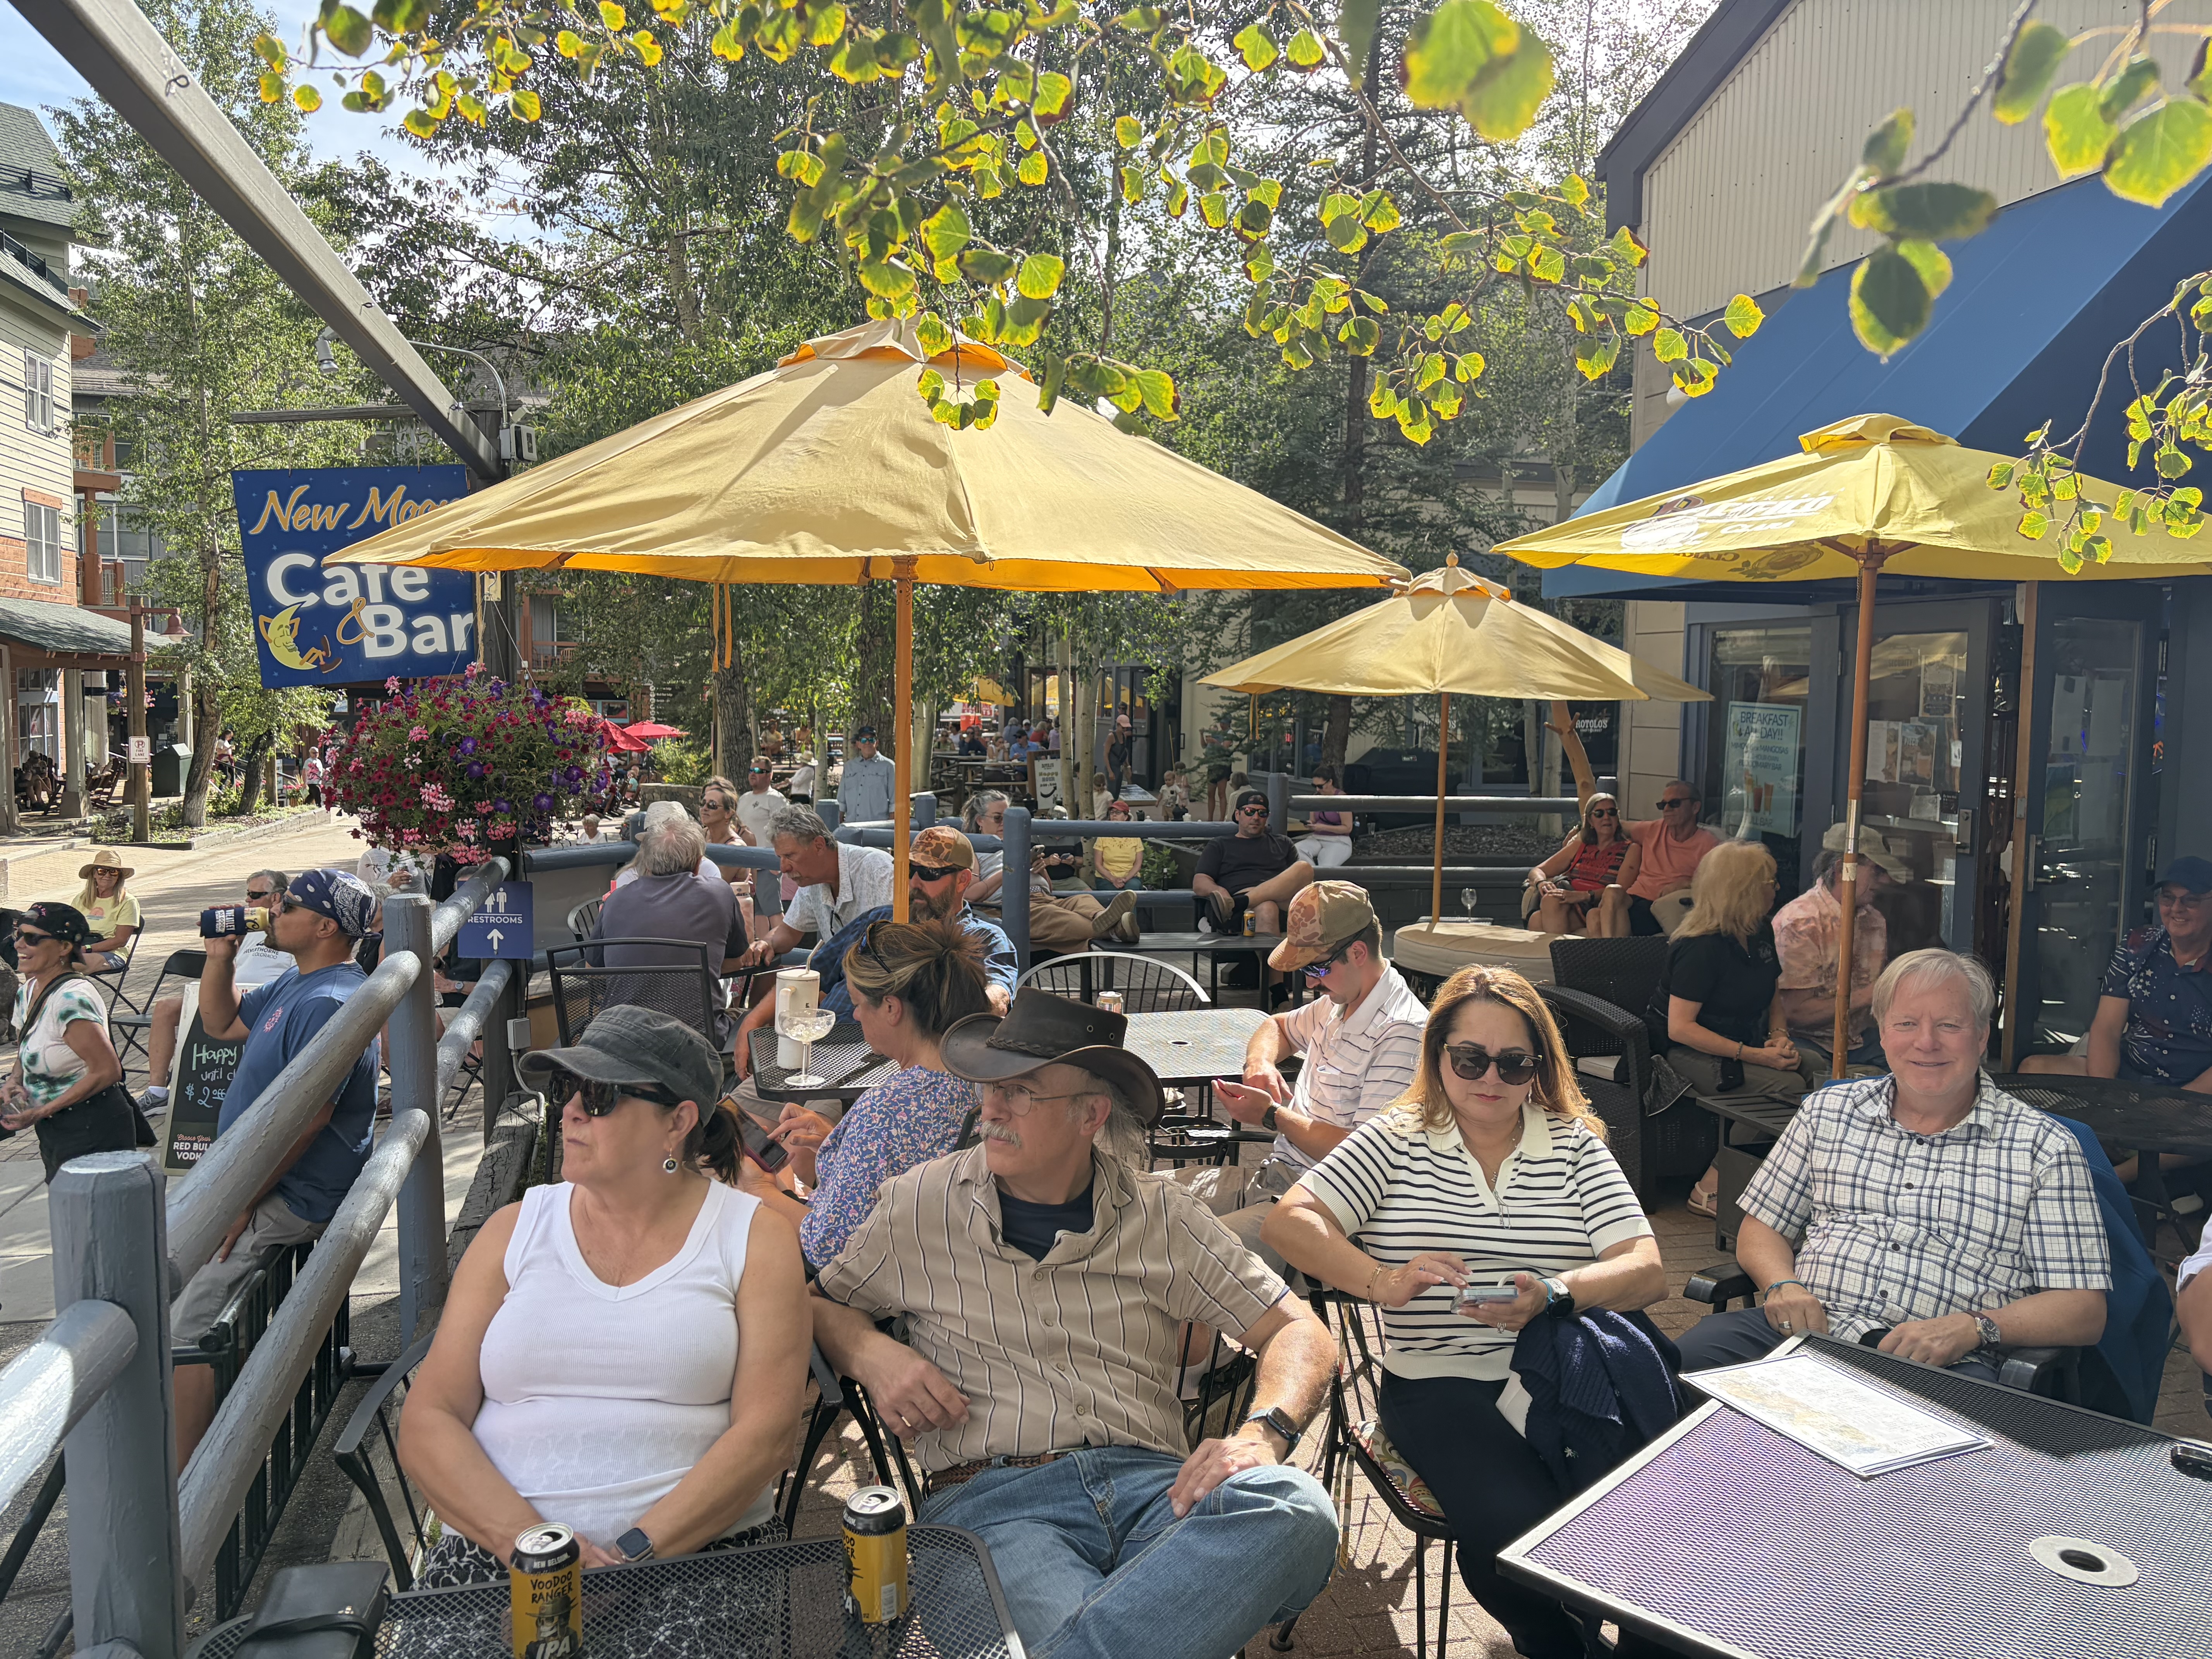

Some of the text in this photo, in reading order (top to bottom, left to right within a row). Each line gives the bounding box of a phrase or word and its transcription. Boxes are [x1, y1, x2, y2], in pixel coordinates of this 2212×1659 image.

[249, 484, 460, 534] New Moo
[336, 597, 375, 645] &
[364, 605, 473, 658] Bar
[1740, 711, 1788, 727] BREAKFAST
[1760, 727, 1783, 740] DAY!!
[192, 1043, 237, 1070] Happy
[201, 1067, 223, 1081] until
[173, 1142, 191, 1150] RED
[176, 1151, 202, 1160] VODK
[531, 1570, 572, 1590] VOODOO
[531, 1582, 573, 1604] RANGER
[536, 1635, 570, 1659] IPA
